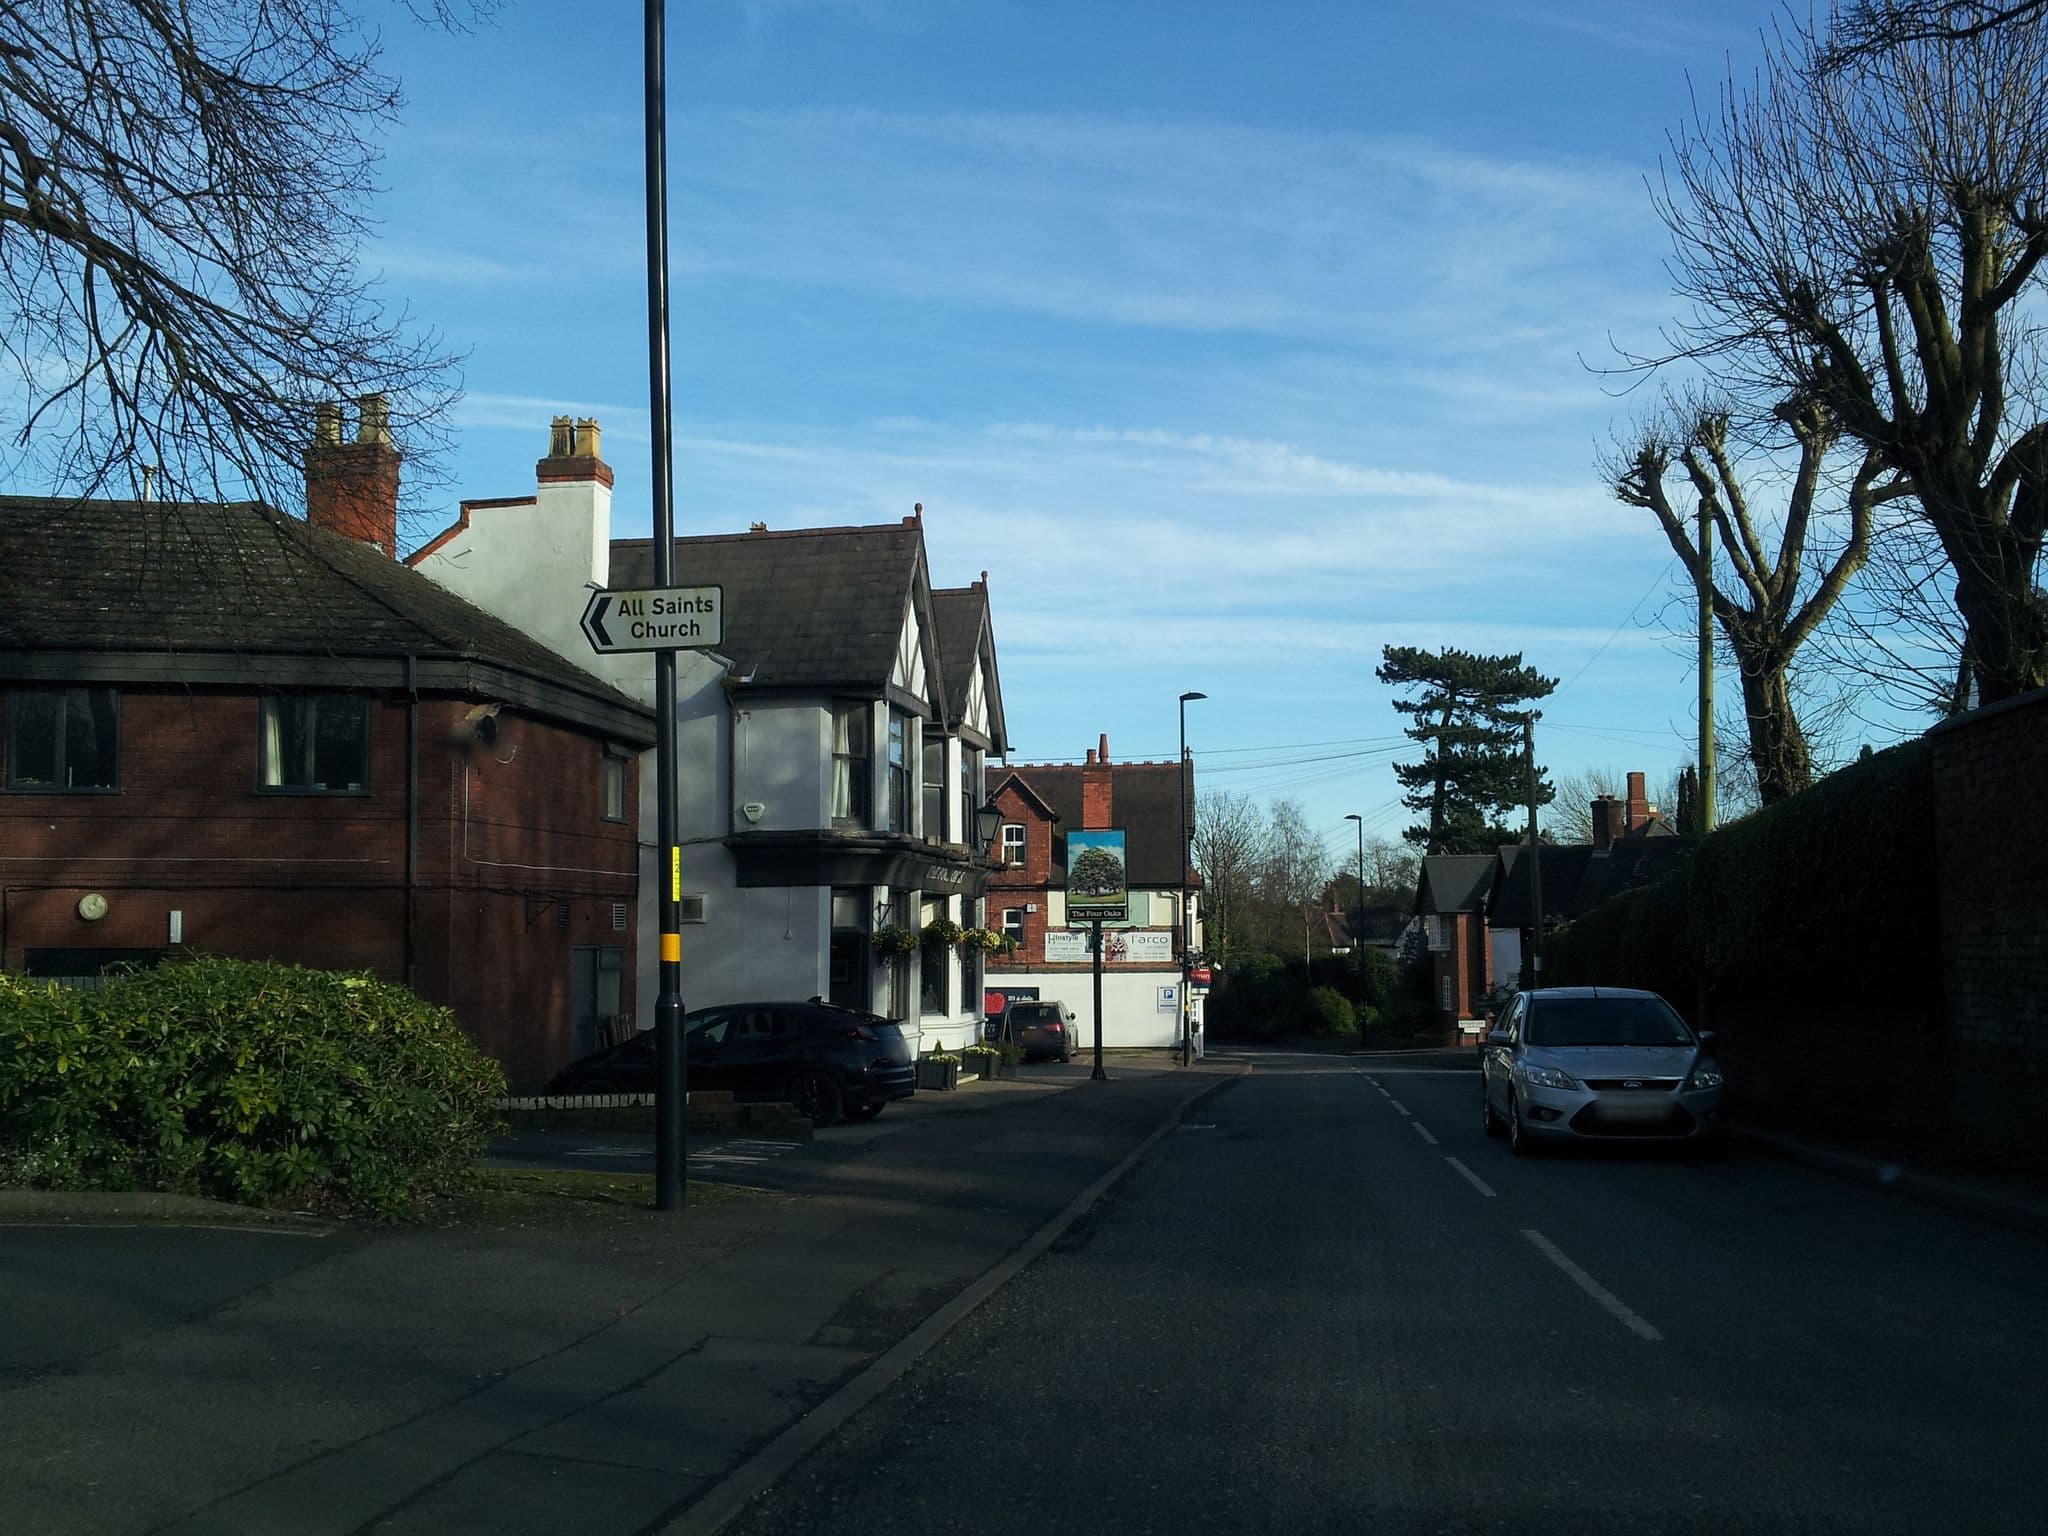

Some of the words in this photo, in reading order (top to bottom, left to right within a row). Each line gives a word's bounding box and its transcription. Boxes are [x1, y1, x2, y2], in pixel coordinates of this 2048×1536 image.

[619, 599, 644, 616] All
[652, 597, 713, 615] Saints
[631, 620, 700, 638] Church
[1103, 909, 1122, 917] Oaks
